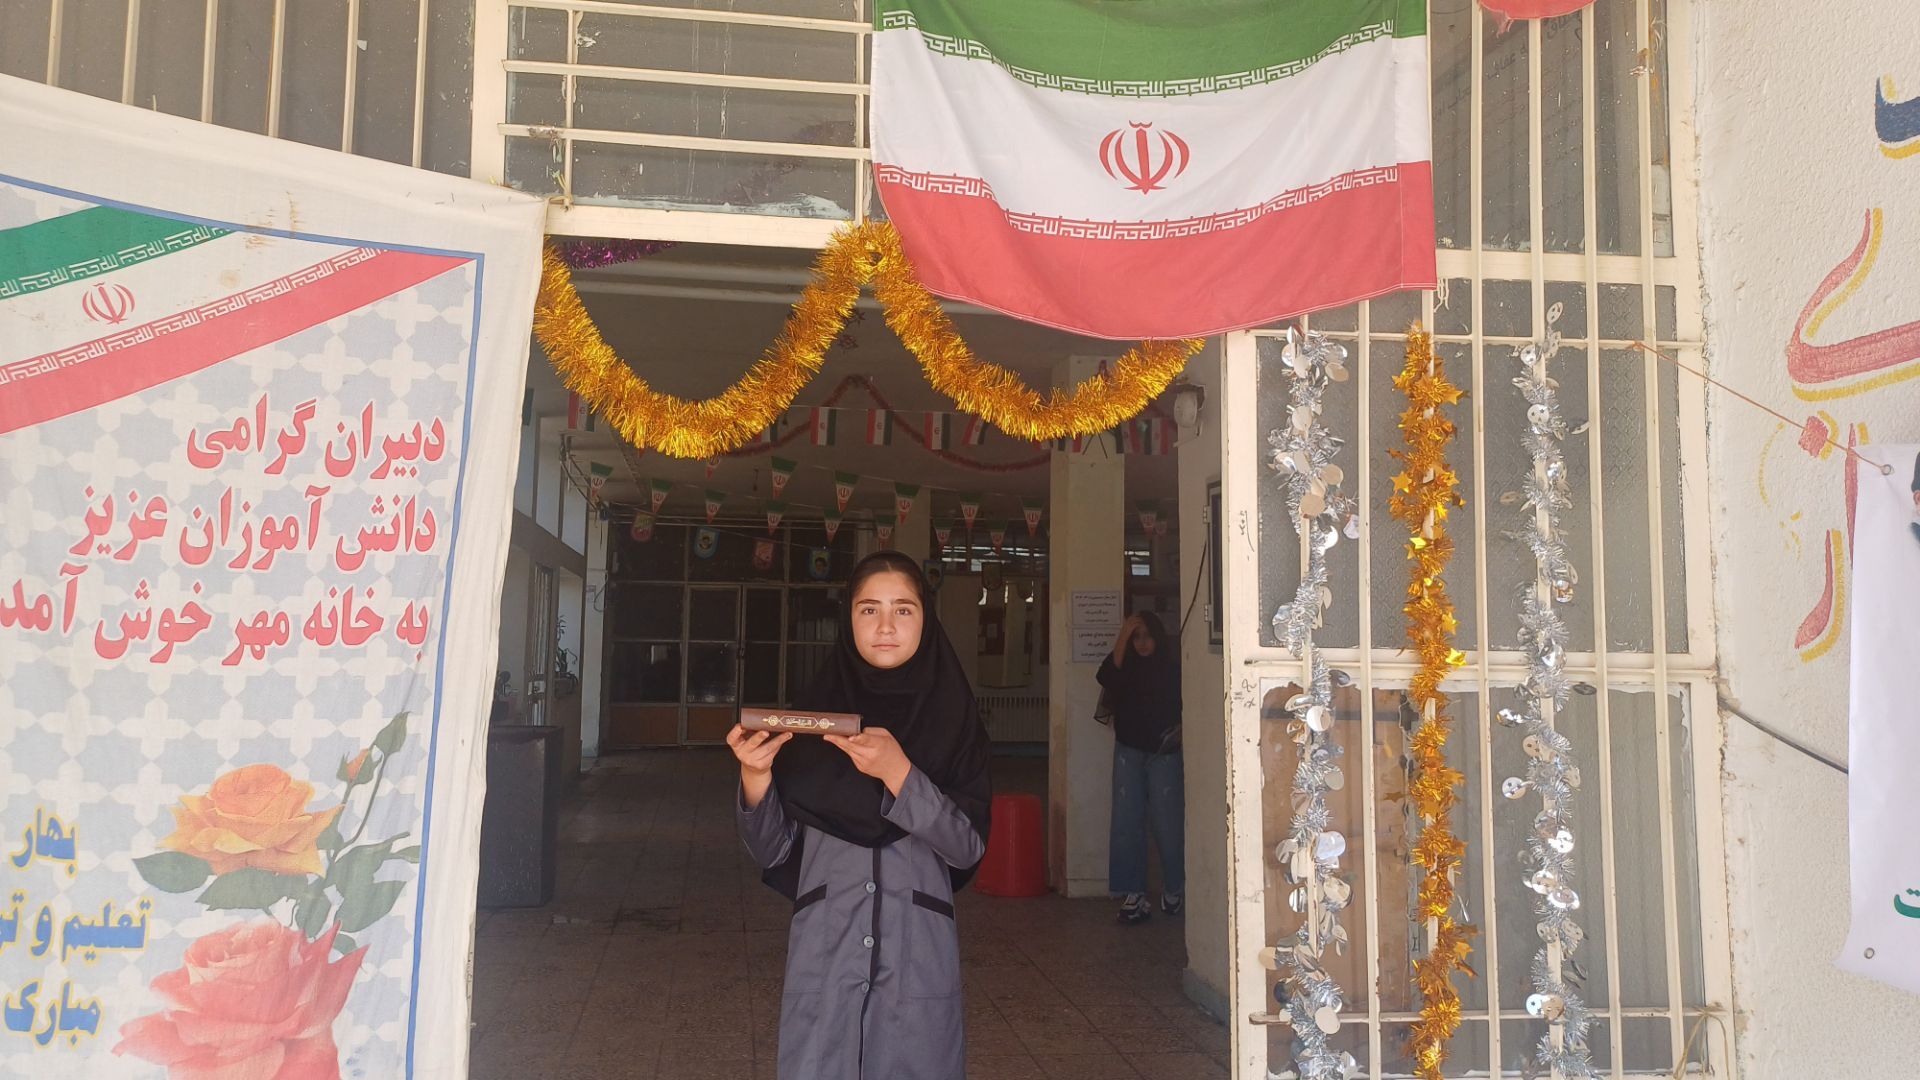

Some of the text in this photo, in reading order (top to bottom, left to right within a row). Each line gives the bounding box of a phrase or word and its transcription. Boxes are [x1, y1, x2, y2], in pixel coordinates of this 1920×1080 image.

[187, 393, 445, 480] دبیران گرامی
[69, 485, 436, 571] دانش آموزان عزیز
[94, 579, 212, 663] خوش
[221, 610, 290, 666] مهر
[303, 585, 384, 646] خانه
[396, 600, 429, 662] به
[11, 808, 78, 874] بهار
[31, 904, 52, 957] و
[62, 899, 151, 962] تعلیم
[4, 980, 102, 1046] مبارک
